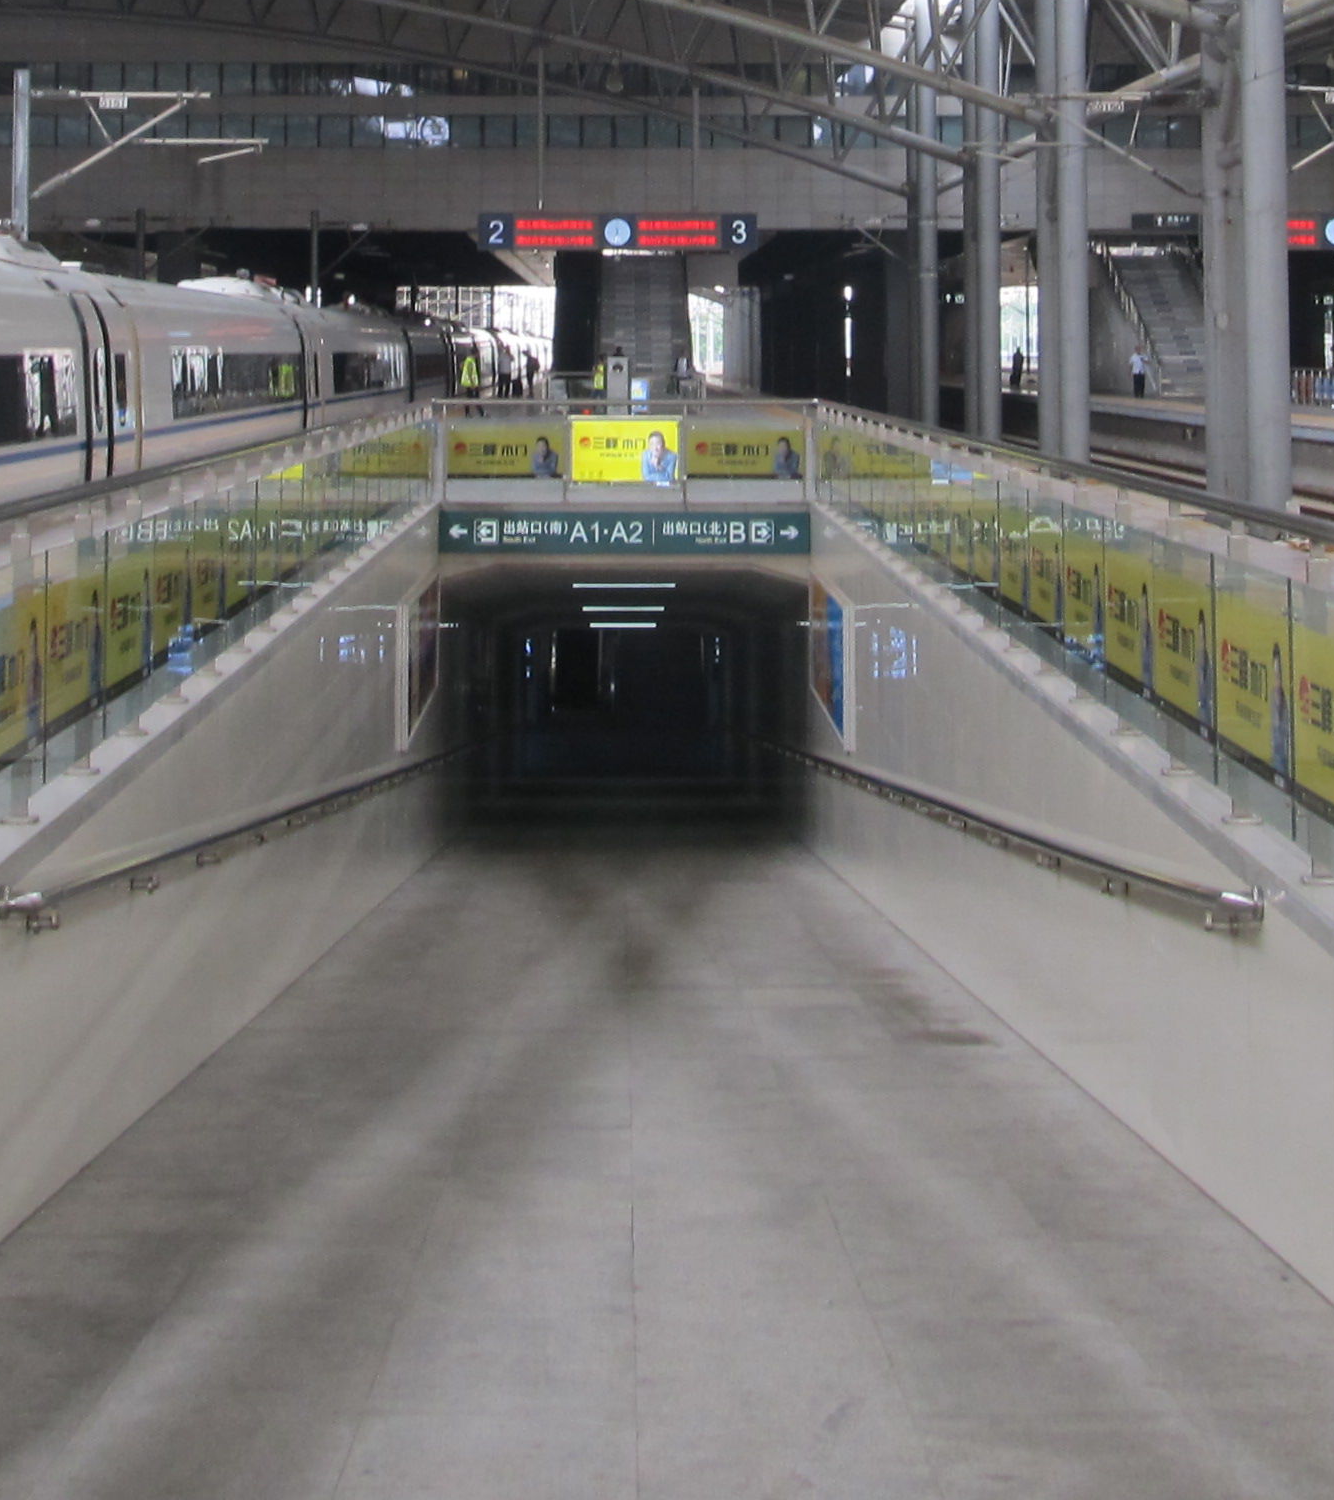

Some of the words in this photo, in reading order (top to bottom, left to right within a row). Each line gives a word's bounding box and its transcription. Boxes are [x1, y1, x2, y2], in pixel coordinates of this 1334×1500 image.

[488, 220, 505, 244] 2
[731, 220, 747, 244] 3
[729, 521, 746, 544] B
